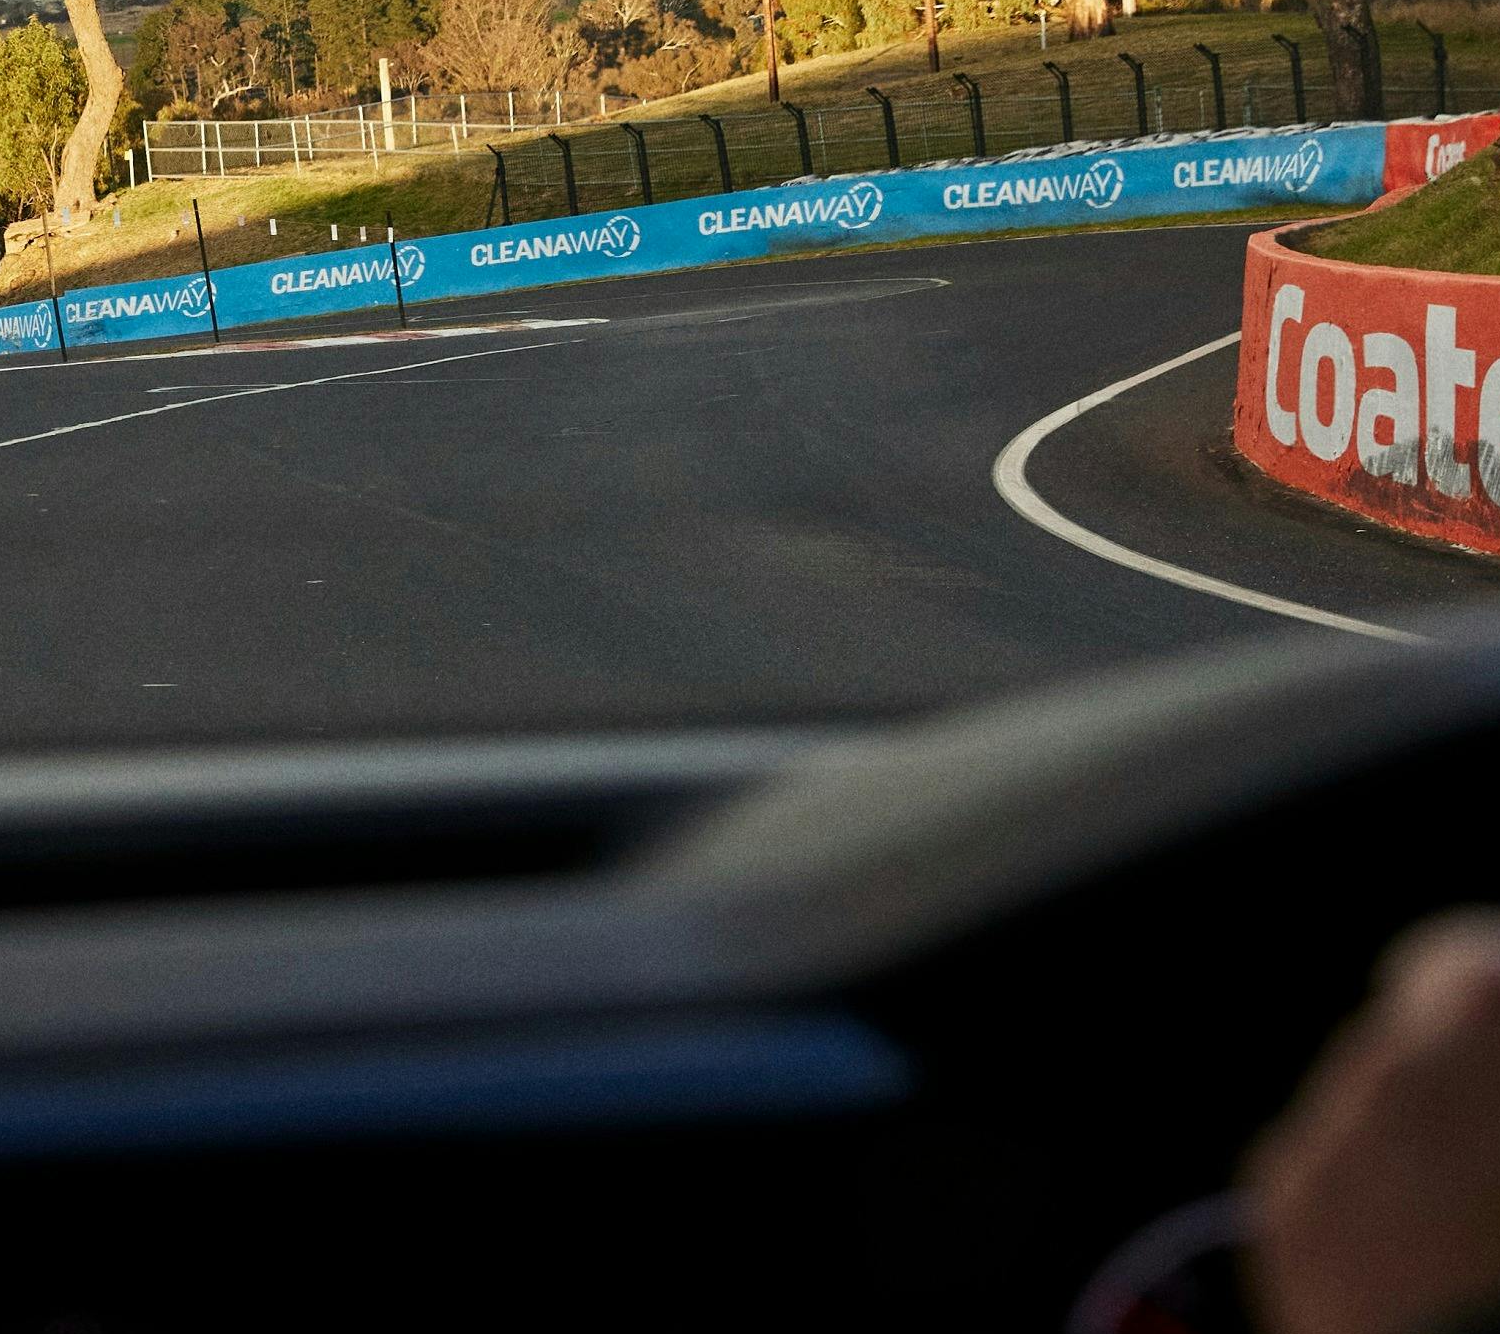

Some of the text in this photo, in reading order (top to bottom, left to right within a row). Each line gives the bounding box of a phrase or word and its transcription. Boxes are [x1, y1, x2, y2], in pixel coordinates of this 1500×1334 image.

[944, 167, 1119, 210] CLEANAWAY
[1174, 148, 1317, 189] CLEANAWAY
[698, 190, 879, 235] CLEANAWAY
[471, 223, 629, 267] CLEANAWAY
[271, 253, 417, 295] CLEANAWAY
[65, 284, 208, 324] CLEANAWAY
